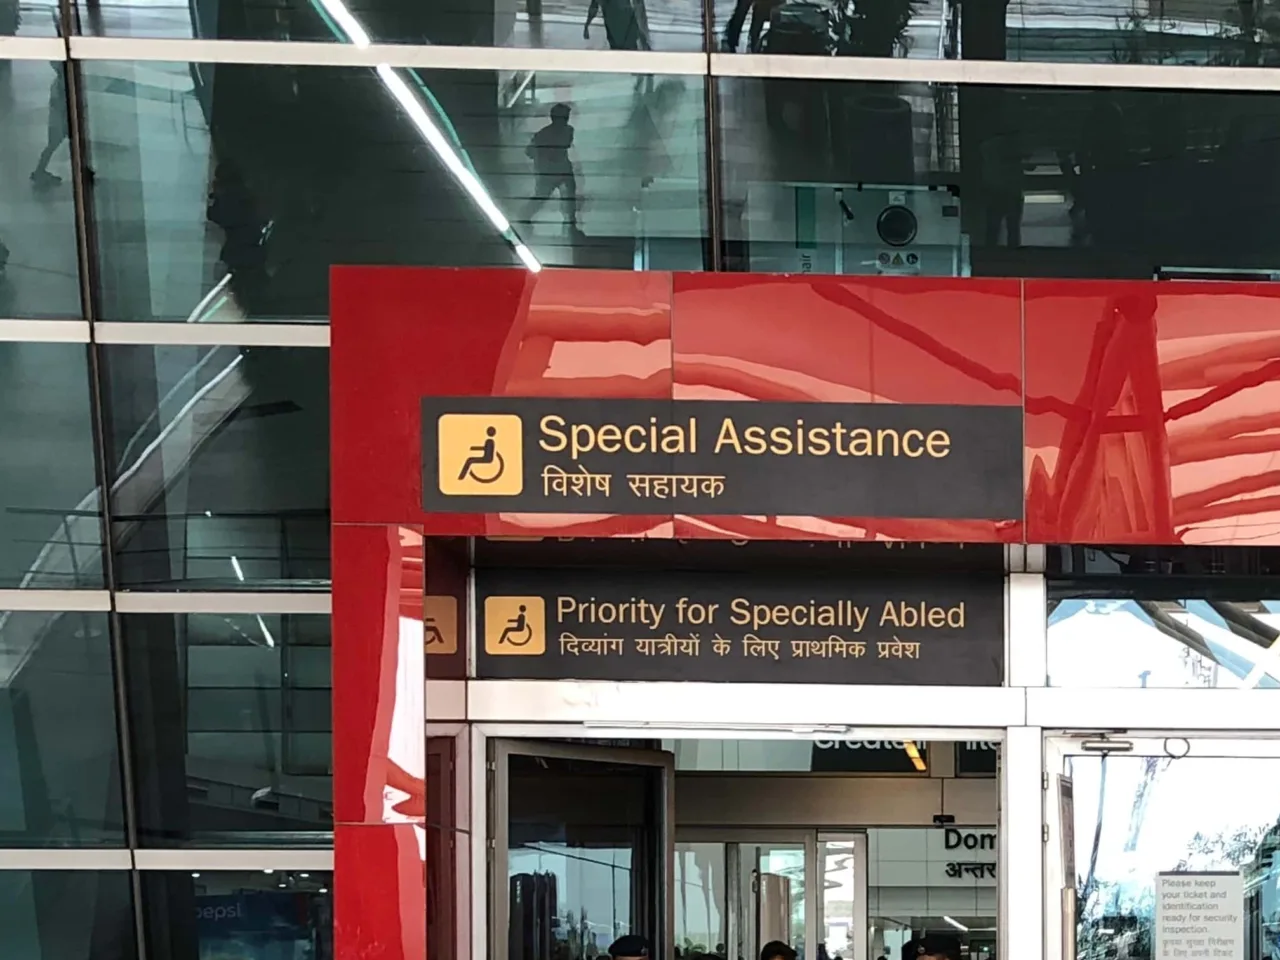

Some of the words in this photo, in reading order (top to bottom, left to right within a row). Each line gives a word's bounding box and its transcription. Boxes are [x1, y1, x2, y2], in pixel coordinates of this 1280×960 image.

[537, 414, 697, 460] Special
[714, 417, 951, 458] Assistance
[541, 464, 611, 497] विशेष
[627, 473, 726, 499] सहायक
[557, 596, 666, 632] Priority
[675, 597, 719, 625] for
[730, 598, 870, 632] Specially
[879, 600, 965, 628] Abled
[558, 632, 624, 657] दिव्यांग
[712, 633, 731, 657] के
[742, 633, 781, 660] लिए
[791, 633, 867, 659] प्राथमिक
[877, 635, 921, 659] प्रवेश
[1162, 879, 1192, 888] Please
[1195, 879, 1216, 889] keep
[1162, 891, 1180, 900] your
[1184, 890, 1208, 899] ticket
[1210, 891, 1227, 899] and
[1204, 914, 1238, 923] security
